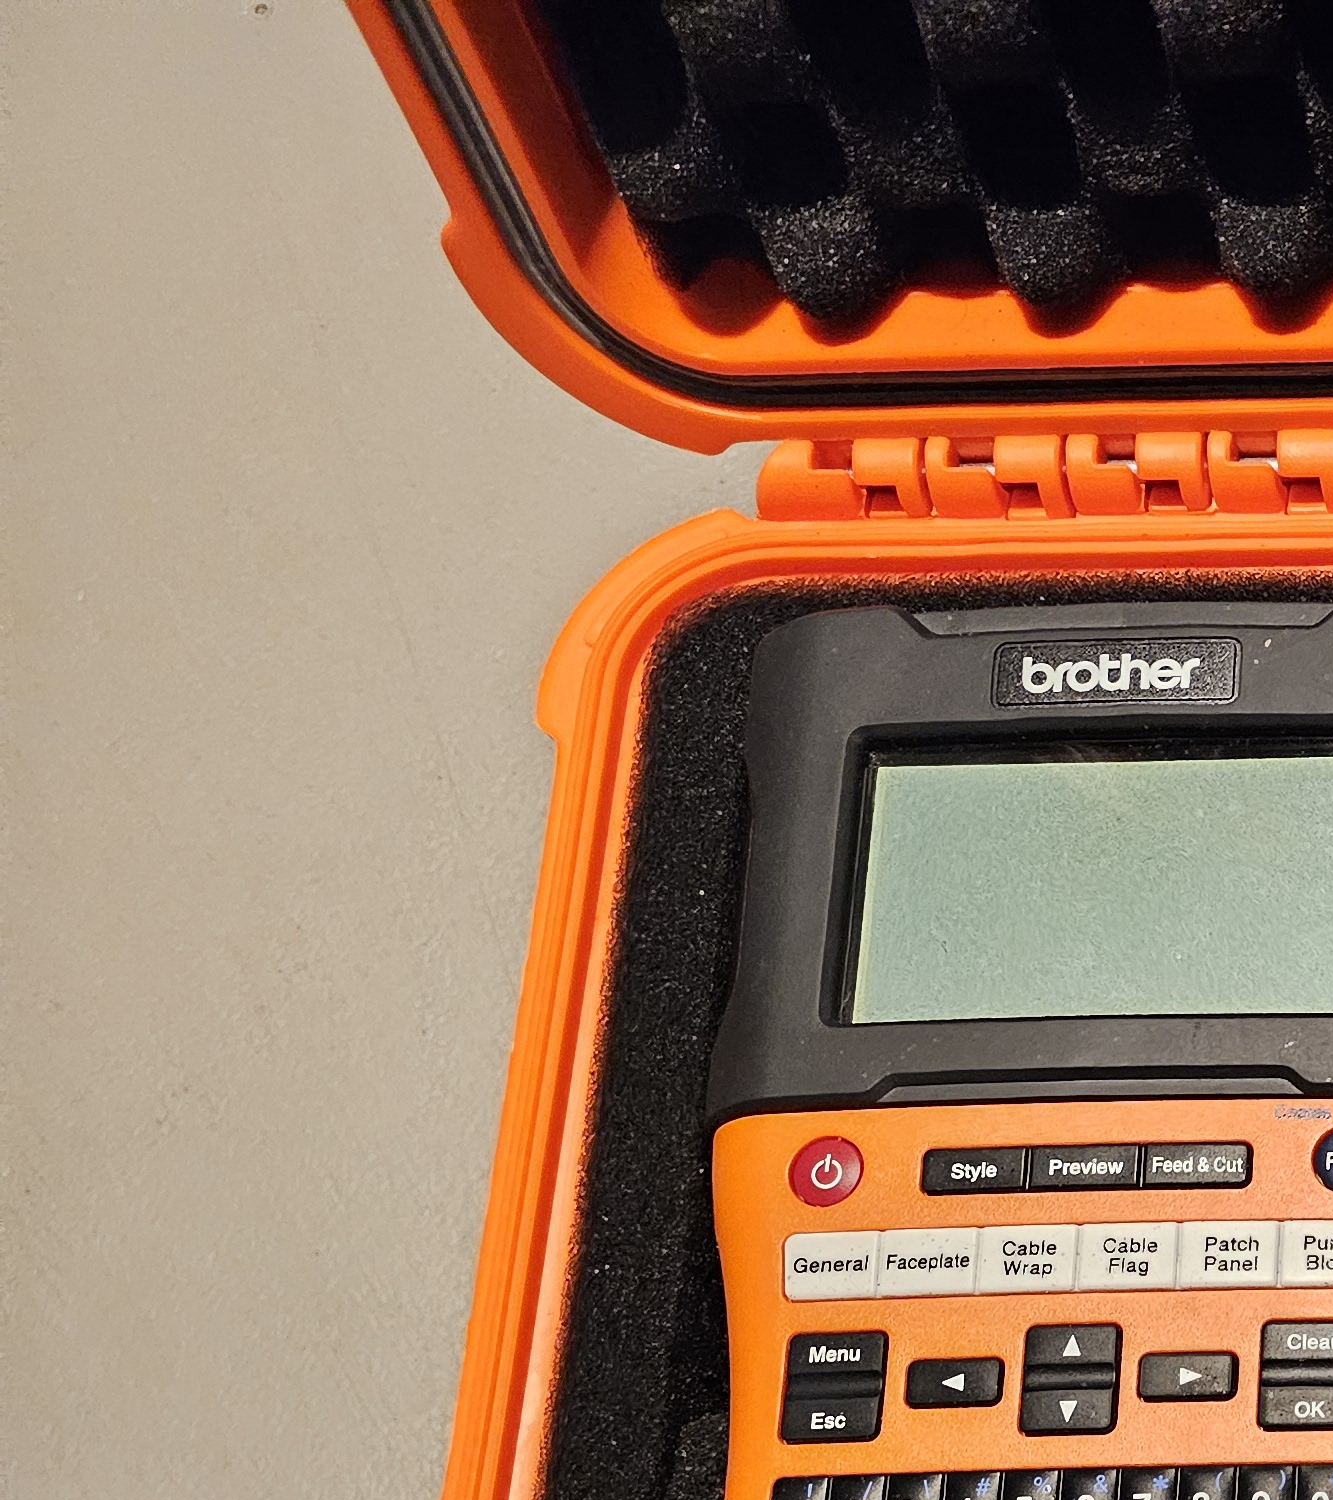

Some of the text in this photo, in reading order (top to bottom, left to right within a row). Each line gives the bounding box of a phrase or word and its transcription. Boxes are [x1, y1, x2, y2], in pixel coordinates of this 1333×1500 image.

[1021, 654, 1200, 694] brother
[950, 1160, 998, 1182] Style
[1048, 1158, 1123, 1178] Preview
[1151, 1154, 1243, 1176] Feed & Cut
[1002, 1239, 1057, 1259] Cable
[1102, 1237, 1158, 1256] Cable
[1204, 1234, 1259, 1254] Patch
[792, 1254, 869, 1273] General
[886, 1252, 970, 1271] Faceplate
[1003, 1258, 1053, 1279] Wrap
[1108, 1256, 1149, 1277] Flag
[1203, 1253, 1258, 1272] Panel
[809, 1344, 861, 1363] Menu
[1294, 1400, 1325, 1419] OK
[810, 1411, 846, 1431] Esc
